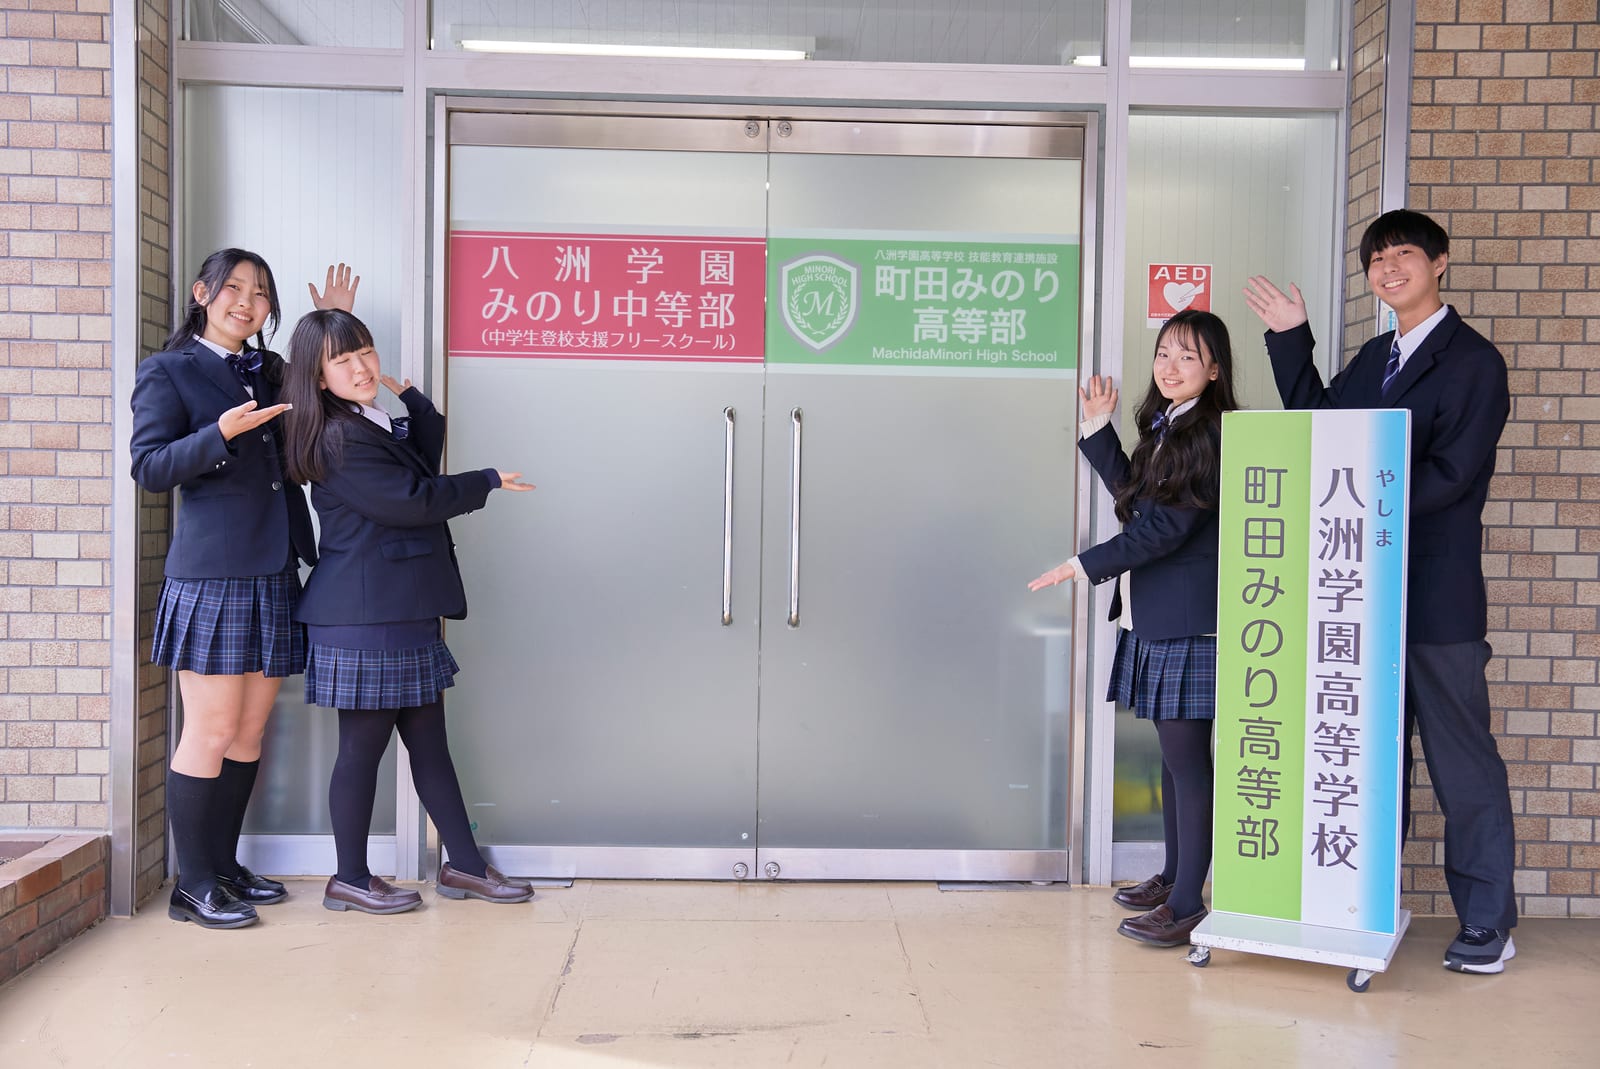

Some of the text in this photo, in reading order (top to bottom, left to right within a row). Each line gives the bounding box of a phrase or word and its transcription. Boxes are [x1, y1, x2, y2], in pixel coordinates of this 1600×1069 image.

[804, 265, 837, 275] MINORI
[874, 249, 1058, 265] 八洲学園高等学校 技能教育連携施設
[1153, 266, 1207, 281] AED
[791, 273, 849, 288] HIGH SCHOOL
[874, 265, 1060, 303] 町田みのり
[481, 287, 735, 329] みのり中等部
[913, 306, 1027, 345] 高等部
[872, 347, 1058, 363] MachidaMinori High School
[1375, 468, 1396, 548] やしま
[1236, 466, 1288, 861] 町田みのり高等部
[1311, 467, 1365, 871] 八洲学園高等学校
